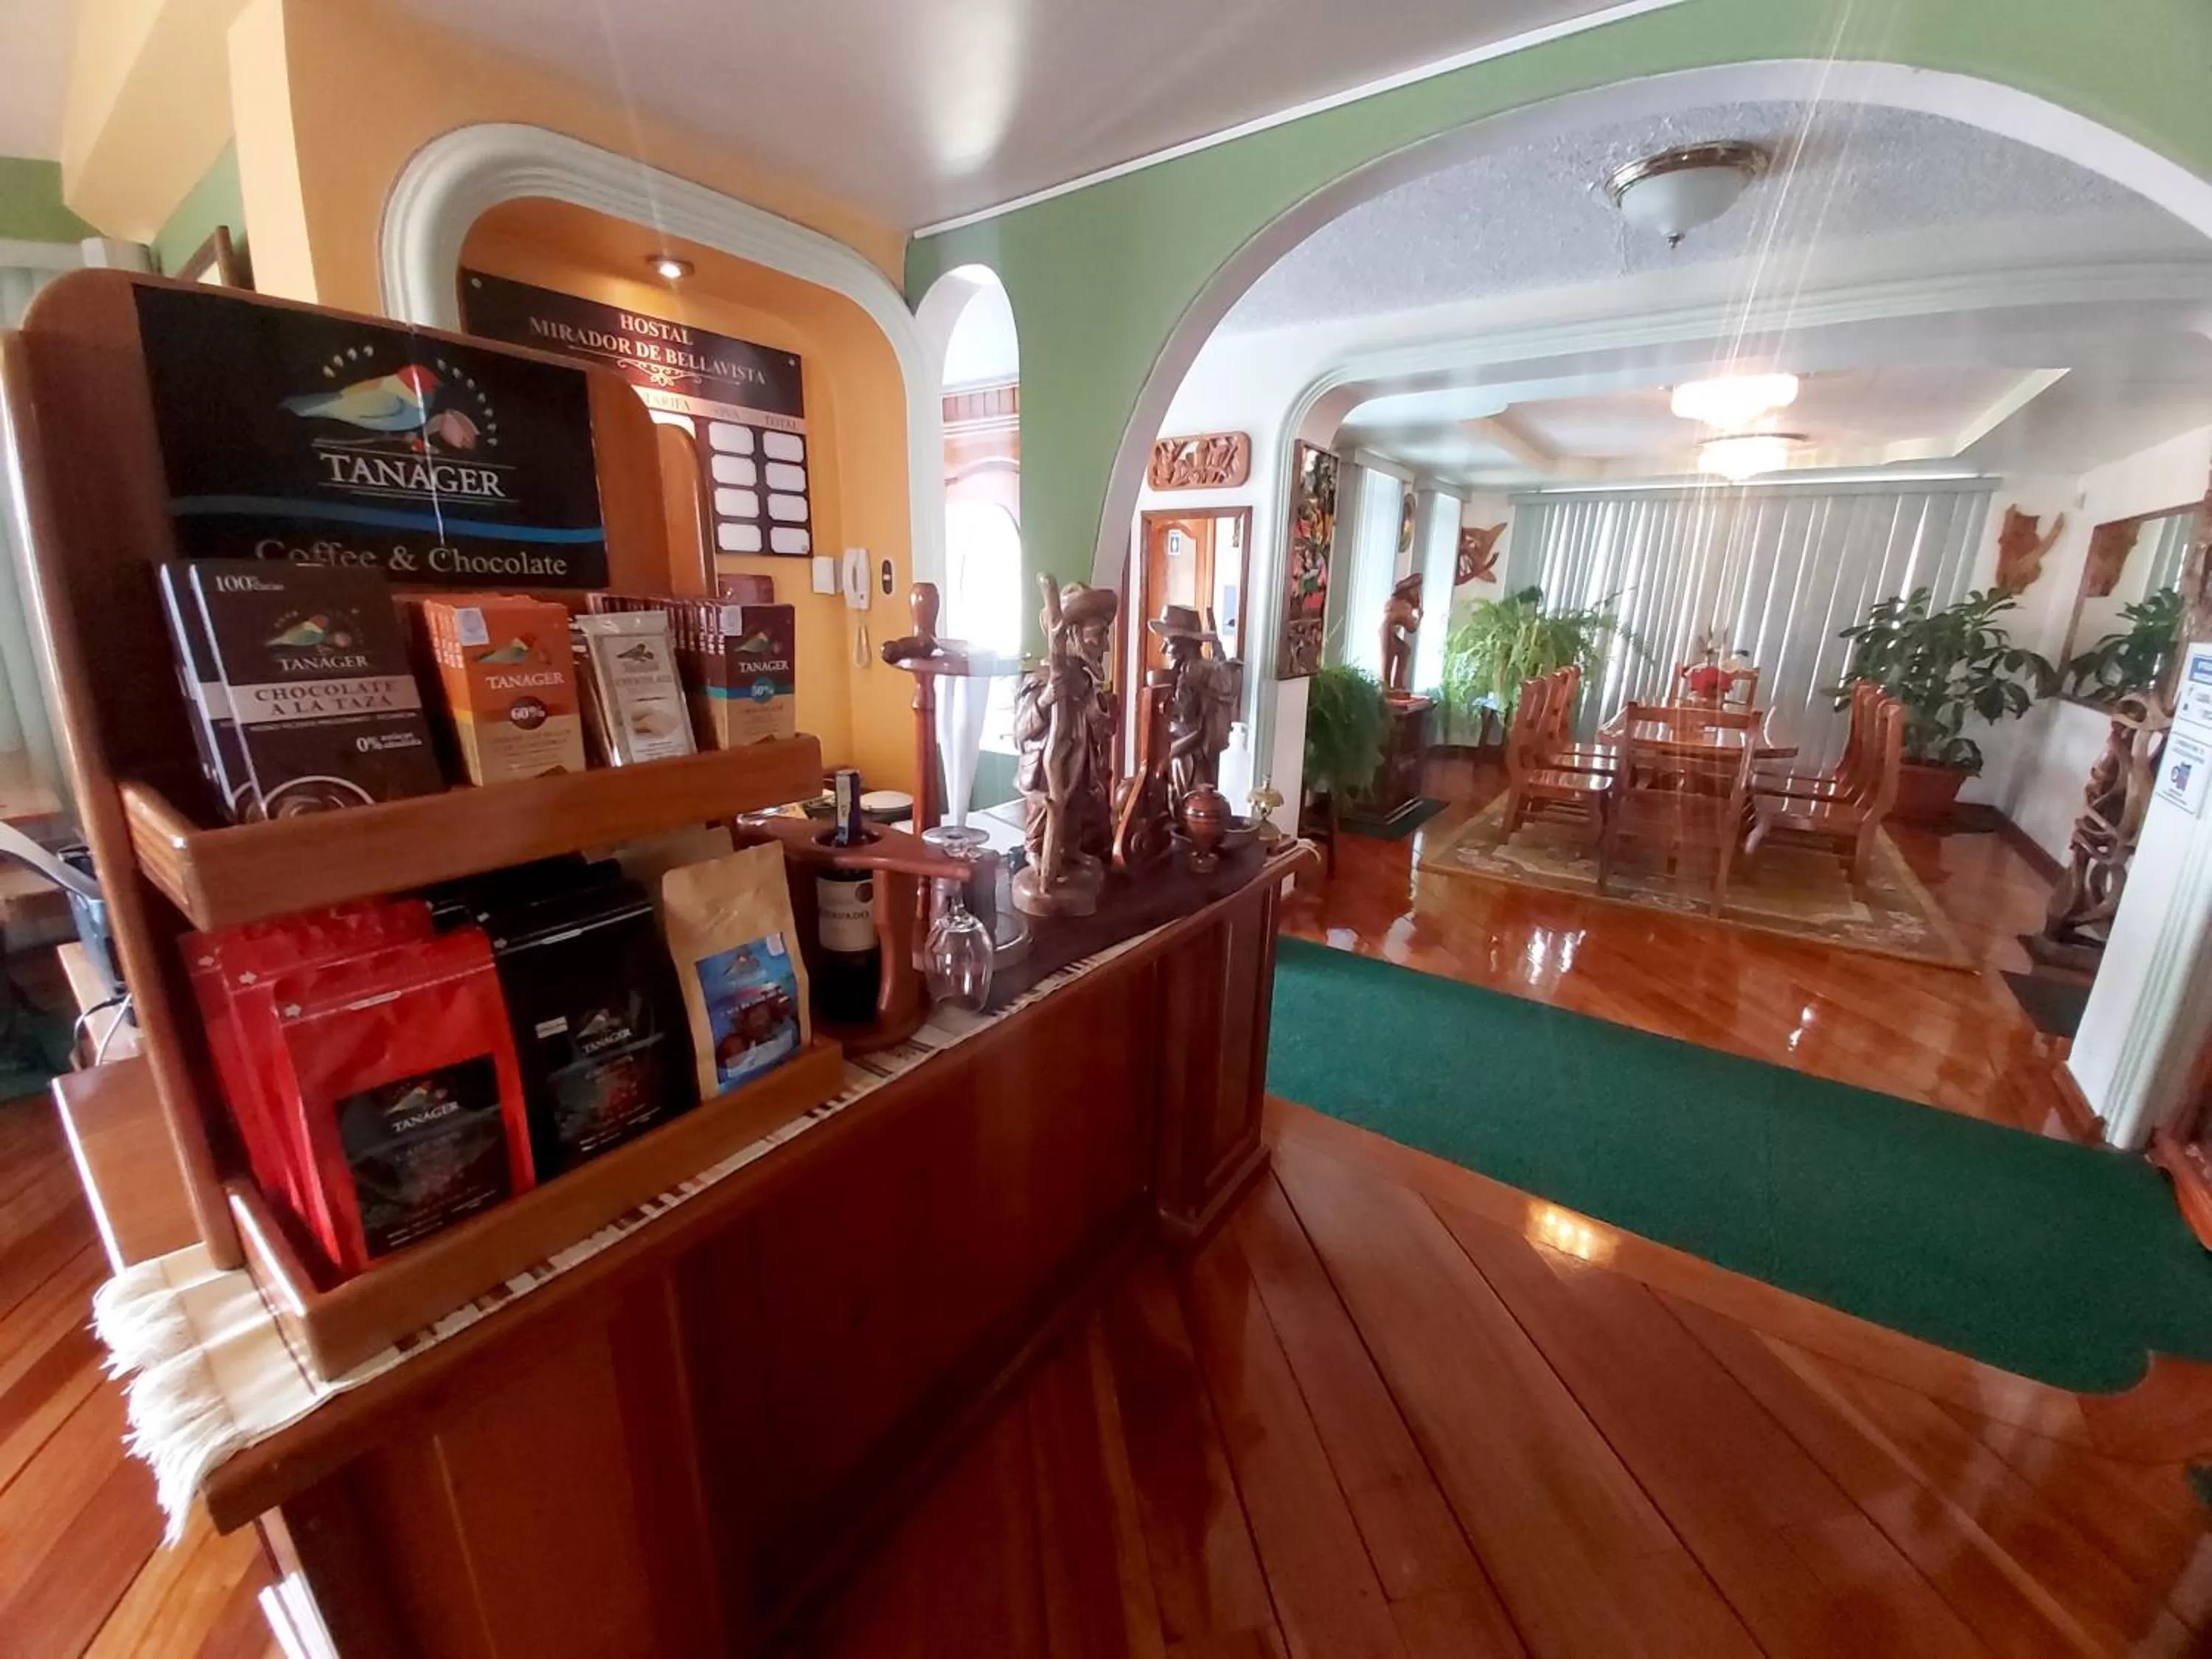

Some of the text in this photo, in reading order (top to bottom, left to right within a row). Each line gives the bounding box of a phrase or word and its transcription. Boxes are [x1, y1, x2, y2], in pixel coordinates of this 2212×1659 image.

[619, 313, 694, 346] HOSTAL
[528, 316, 766, 386] MIRADOR DE BELLAVISTA
[319, 451, 507, 498] TANAGER
[254, 538, 568, 576] Coffee & Chocolate
[279, 654, 369, 672] TANAGER
[738, 659, 790, 674] TANAGER
[254, 680, 399, 703] CHOCOLATE
[484, 671, 566, 690] TANAGER
[271, 695, 394, 717] A LA TAZA
[510, 704, 546, 721] 60%
[582, 1028, 634, 1054] TANAGER
[392, 1100, 461, 1133] TANAGER
